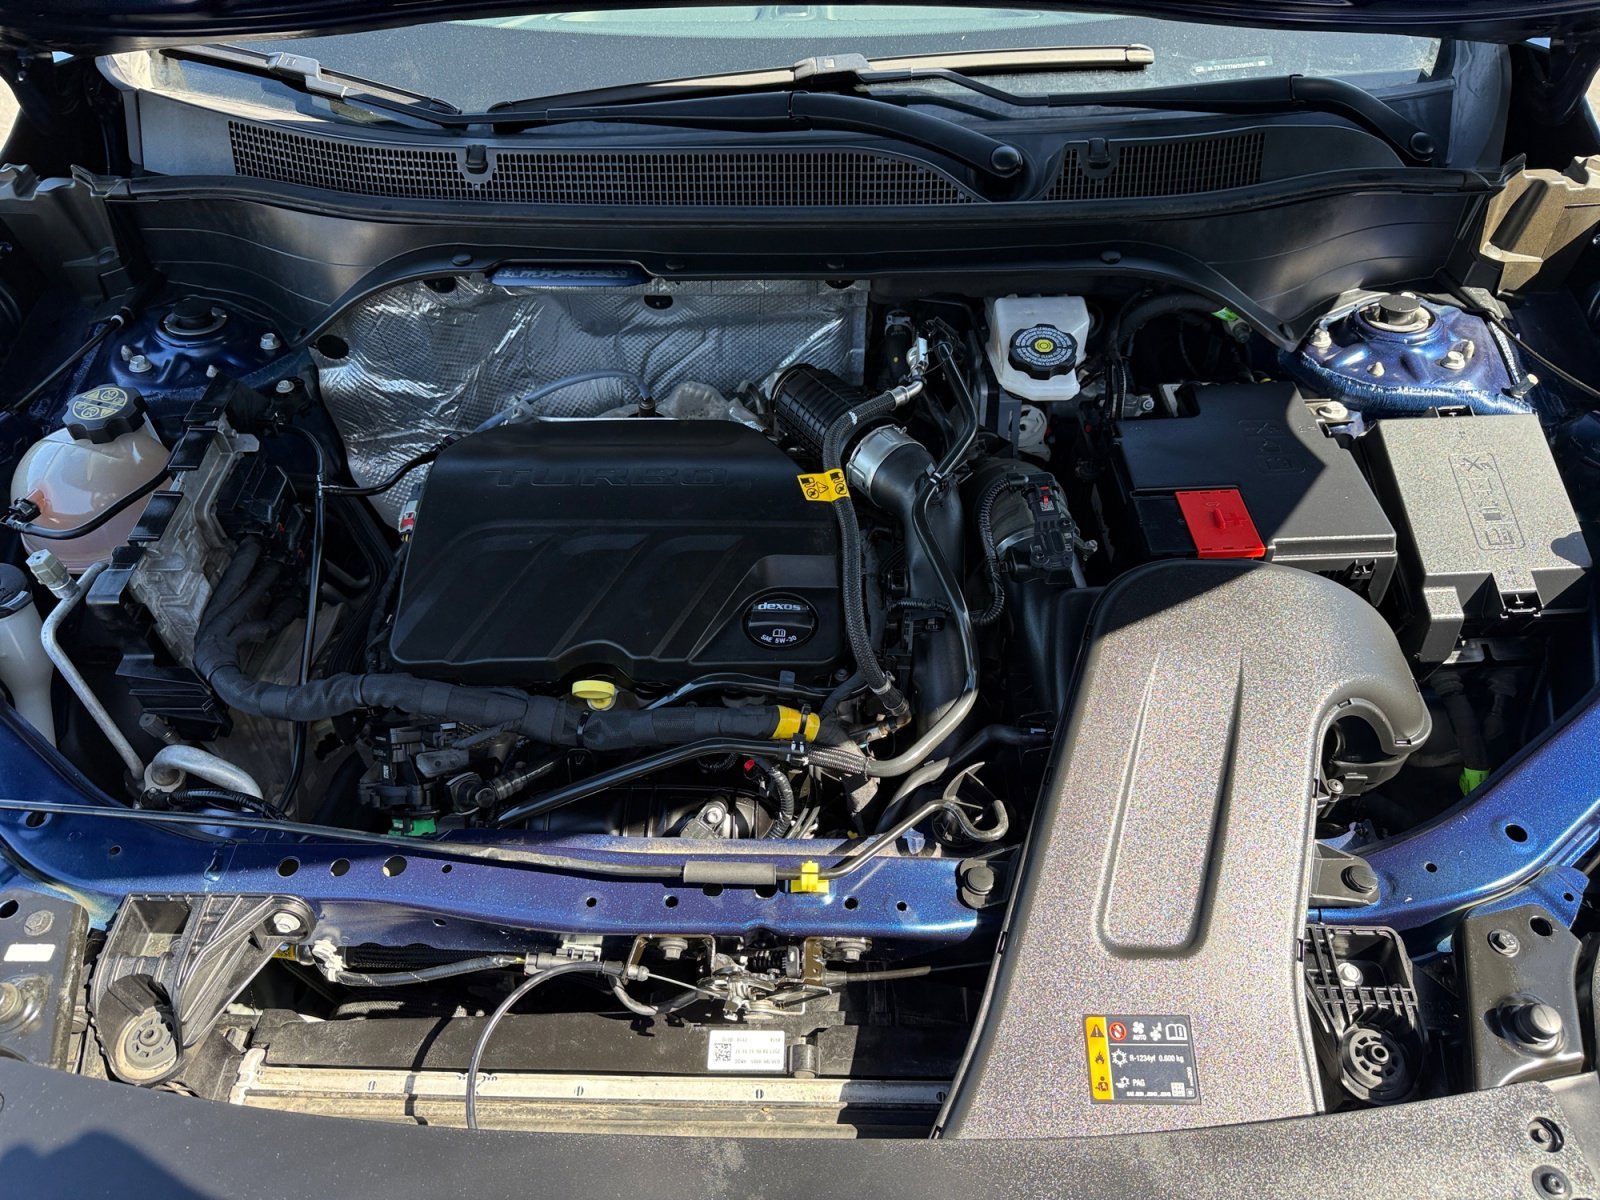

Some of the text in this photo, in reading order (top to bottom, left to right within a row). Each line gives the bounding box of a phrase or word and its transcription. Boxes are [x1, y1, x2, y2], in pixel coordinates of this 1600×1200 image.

[484, 466, 728, 487] TURBO
[758, 602, 800, 610] dexos
[760, 634, 772, 642] SAE
[1176, 1054, 1184, 1063] kg
